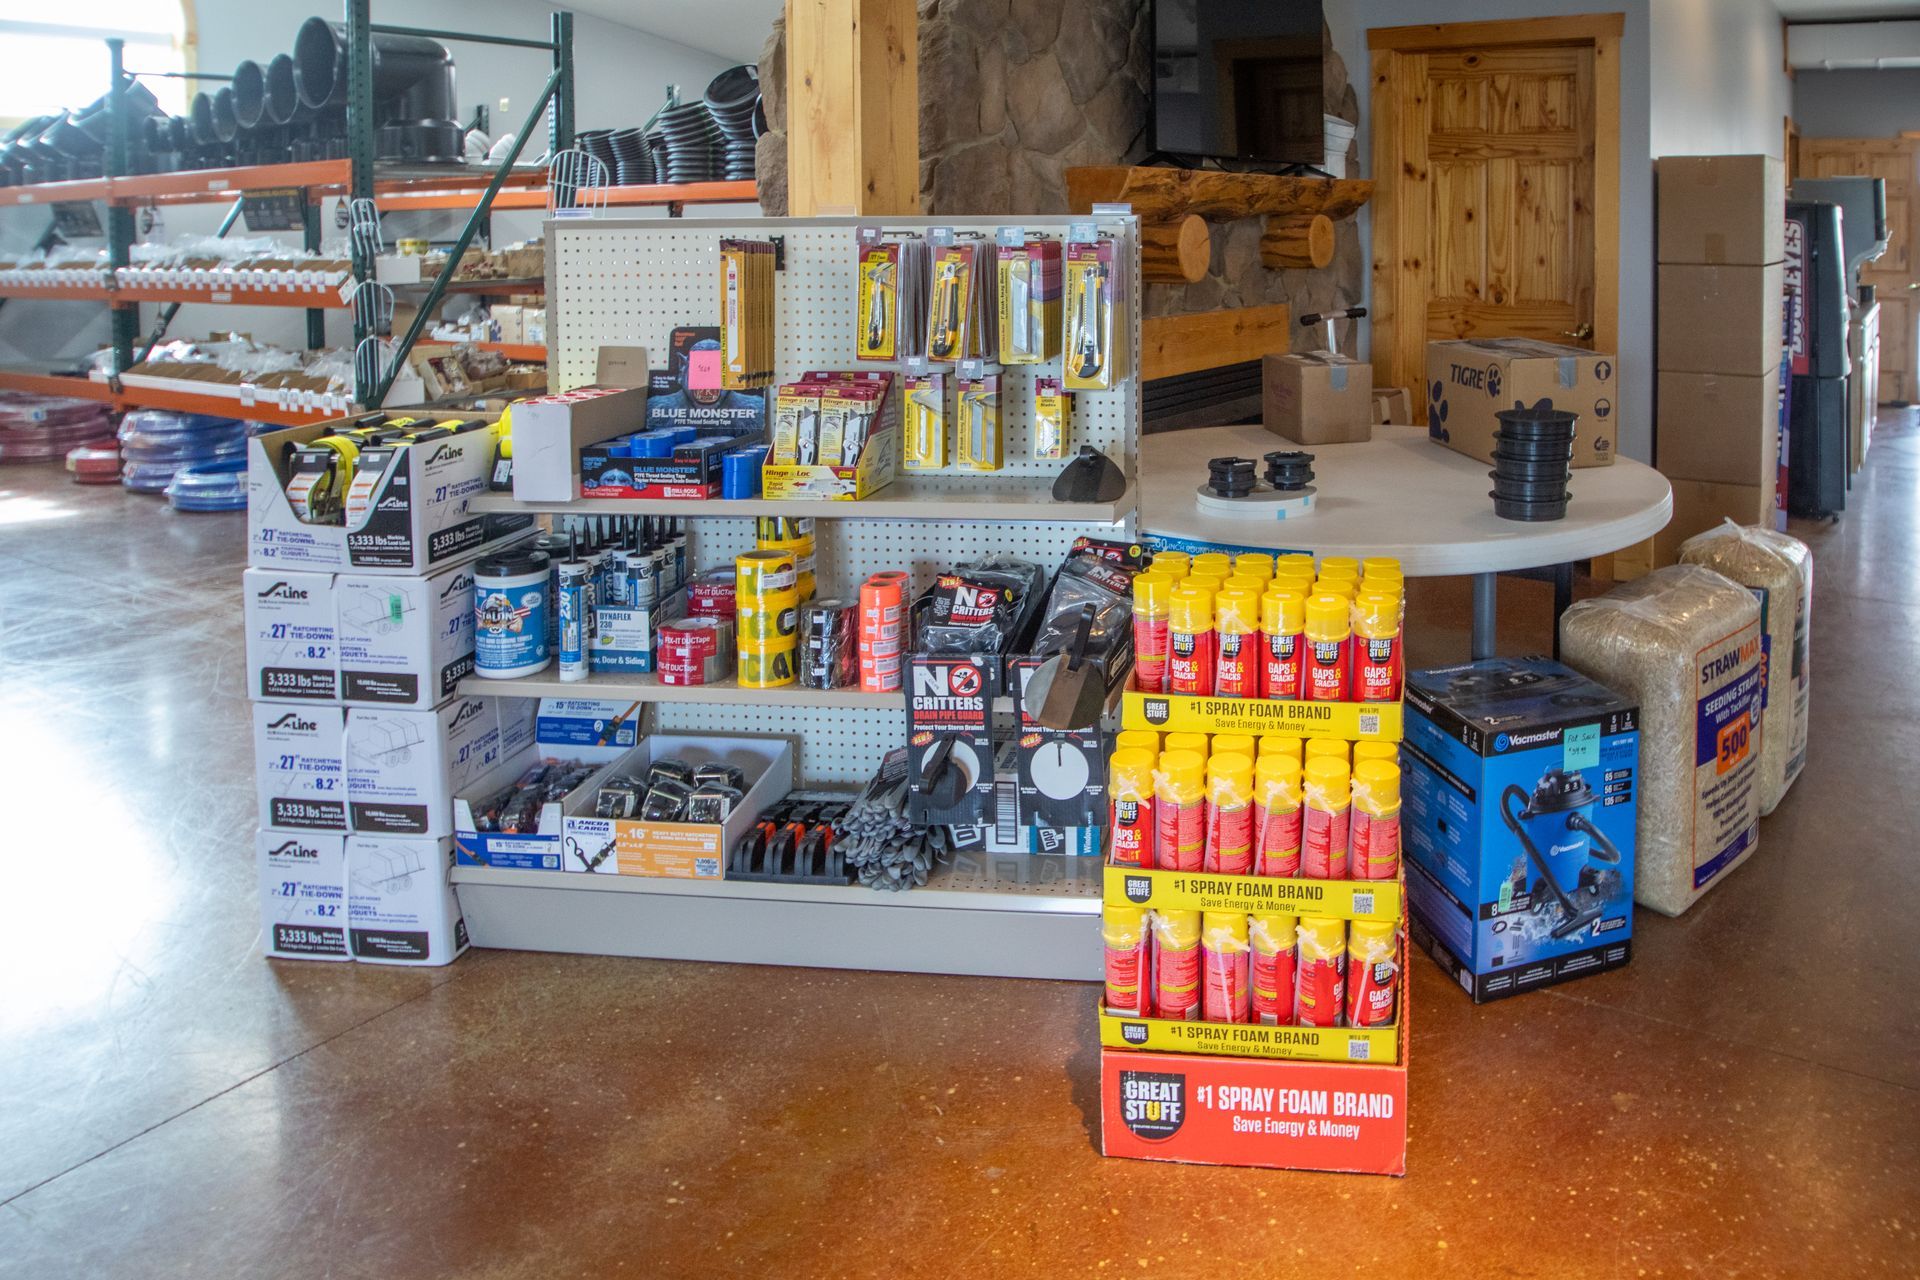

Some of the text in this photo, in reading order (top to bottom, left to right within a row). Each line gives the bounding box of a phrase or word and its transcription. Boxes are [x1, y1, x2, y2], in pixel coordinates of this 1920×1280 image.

[1450, 364, 1484, 390] TIGRE
[652, 408, 755, 418] BLUE MONSTER
[276, 537, 315, 545] TIE-DOWNS
[349, 535, 373, 546] 3,333
[375, 535, 387, 546] lbs
[432, 530, 465, 551] 3,333 lbs
[560, 591, 572, 619] 230
[952, 605, 995, 616] CRITTERS
[682, 637, 710, 645] DUCTape
[1173, 634, 1193, 642] GREAT
[1272, 635, 1294, 644] GREAT
[1174, 642, 1194, 651] STUFF
[1272, 644, 1294, 653] STUFF
[1316, 642, 1338, 651] GREAT
[1370, 640, 1391, 649] GREAT
[308, 646, 326, 659] 8.2
[1316, 650, 1338, 659] STUFF
[1369, 648, 1390, 657] STUFF
[625, 656, 645, 666] Siding
[1172, 659, 1190, 672] GAPS
[446, 662, 465, 683] 3,333
[1268, 663, 1297, 674] GAPS &
[1312, 667, 1341, 680] GAPS &
[1364, 666, 1392, 678] GAPS &
[268, 672, 296, 686] 3,333
[298, 674, 312, 687] lbs
[1174, 671, 1195, 679] CRACKS
[1271, 674, 1294, 682] CRACKS
[1315, 679, 1339, 687] CRACKS
[1705, 668, 1760, 717] SEEDING STRAW
[913, 697, 984, 710] CRITTERS
[1146, 702, 1166, 711] GREAT
[1404, 688, 1434, 714] Vacmaster
[914, 711, 984, 720] DRAIN PIPE GUARD
[1146, 710, 1167, 719] STUFF
[1191, 702, 1331, 720] #1 SPRAY FOAM BRAND
[1716, 708, 1729, 724] With
[1215, 718, 1305, 732] Save Energy & Money
[1612, 715, 1617, 723] 5
[1509, 729, 1560, 746] Vacmaster
[1721, 726, 1746, 762] 500
[316, 778, 334, 790] 8.2
[1605, 797, 1614, 806] 135
[277, 803, 304, 816] 3,333
[306, 805, 320, 818] lbs
[629, 828, 645, 839] 16
[1042, 831, 1055, 848] DAP
[1559, 841, 1584, 853] Vacmaster
[1128, 880, 1149, 889] GREAT
[1174, 879, 1323, 900] #1 SPRAY FOAM BRAND
[1128, 888, 1150, 897] STUFF
[318, 904, 336, 916] 8.2
[1201, 898, 1296, 912] Save Energy & Money
[1491, 904, 1497, 916] 8
[1592, 918, 1600, 937] 2
[279, 929, 322, 944] 3,333 lbs
[1171, 1026, 1319, 1045] #1 SPRAY FOAM BRAND
[1198, 1041, 1217, 1051] Save
[1220, 1042, 1251, 1053] Energy
[1262, 1045, 1292, 1055] Money
[1126, 1080, 1180, 1101] GREAT
[1197, 1085, 1393, 1118] #1 SPRAY FOAM BRAND
[1126, 1100, 1180, 1122] STUFF
[1233, 1116, 1360, 1140] Save Energy & Money
